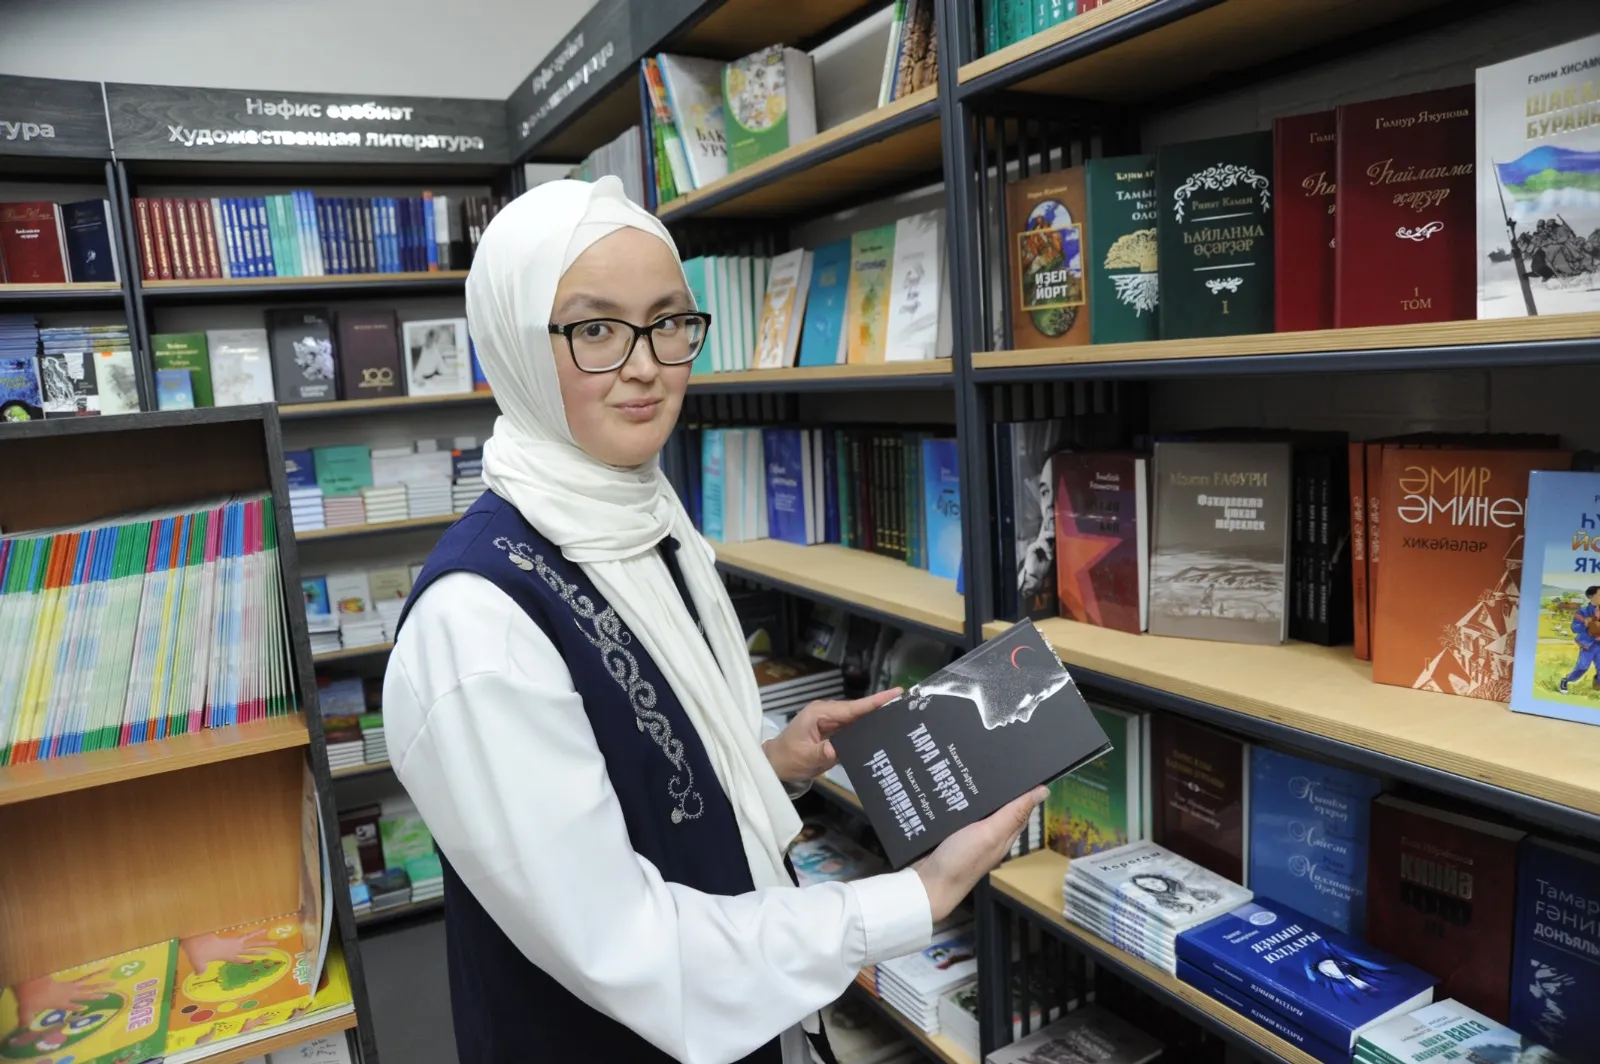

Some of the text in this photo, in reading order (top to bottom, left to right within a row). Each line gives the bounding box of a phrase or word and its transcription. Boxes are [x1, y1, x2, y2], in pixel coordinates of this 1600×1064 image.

[1560, 55, 1600, 77] ХИСАМ
[246, 97, 322, 120] Нәфис
[167, 124, 484, 152] Художественная литература
[1035, 284, 1068, 300] ЙОРТ
[1400, 298, 1432, 311] ТОМ
[1413, 286, 1420, 298] 1
[361, 366, 394, 382] 100
[1399, 465, 1492, 497] ӘМИР
[1402, 535, 1489, 554] ХИКӘЙӘЛӘР
[863, 748, 927, 842] ЧЕРНОЛИКИЕ
[904, 766, 936, 822] Мажит Гафури
[1535, 899, 1600, 938] ҒӘНИ
[1250, 923, 1304, 954] ЯҘМЫШ
[1262, 930, 1322, 965] ЮЛДАРЫ
